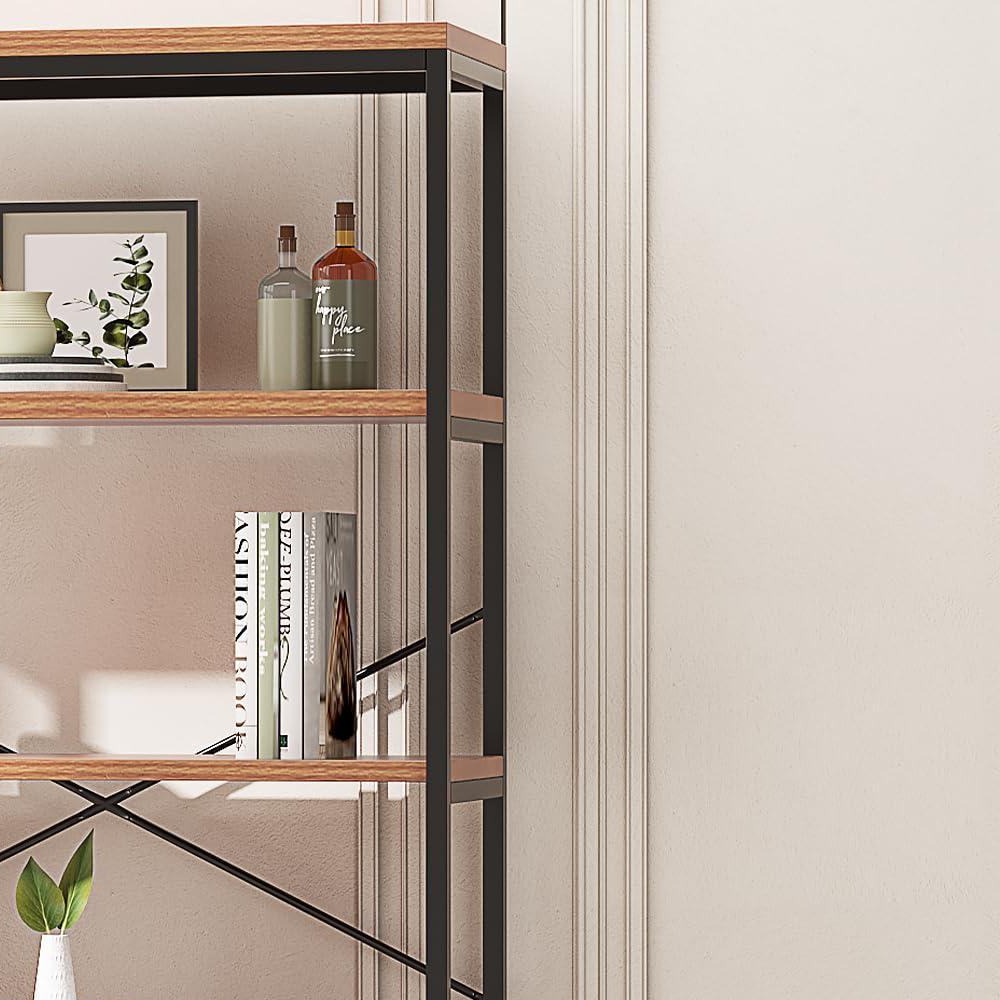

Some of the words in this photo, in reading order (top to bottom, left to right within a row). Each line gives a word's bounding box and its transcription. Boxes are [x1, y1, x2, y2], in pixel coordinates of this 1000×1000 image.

[315, 293, 347, 326] happy
[331, 313, 365, 345] place
[309, 517, 317, 549] Pizza
[235, 511, 249, 643] ASHION
